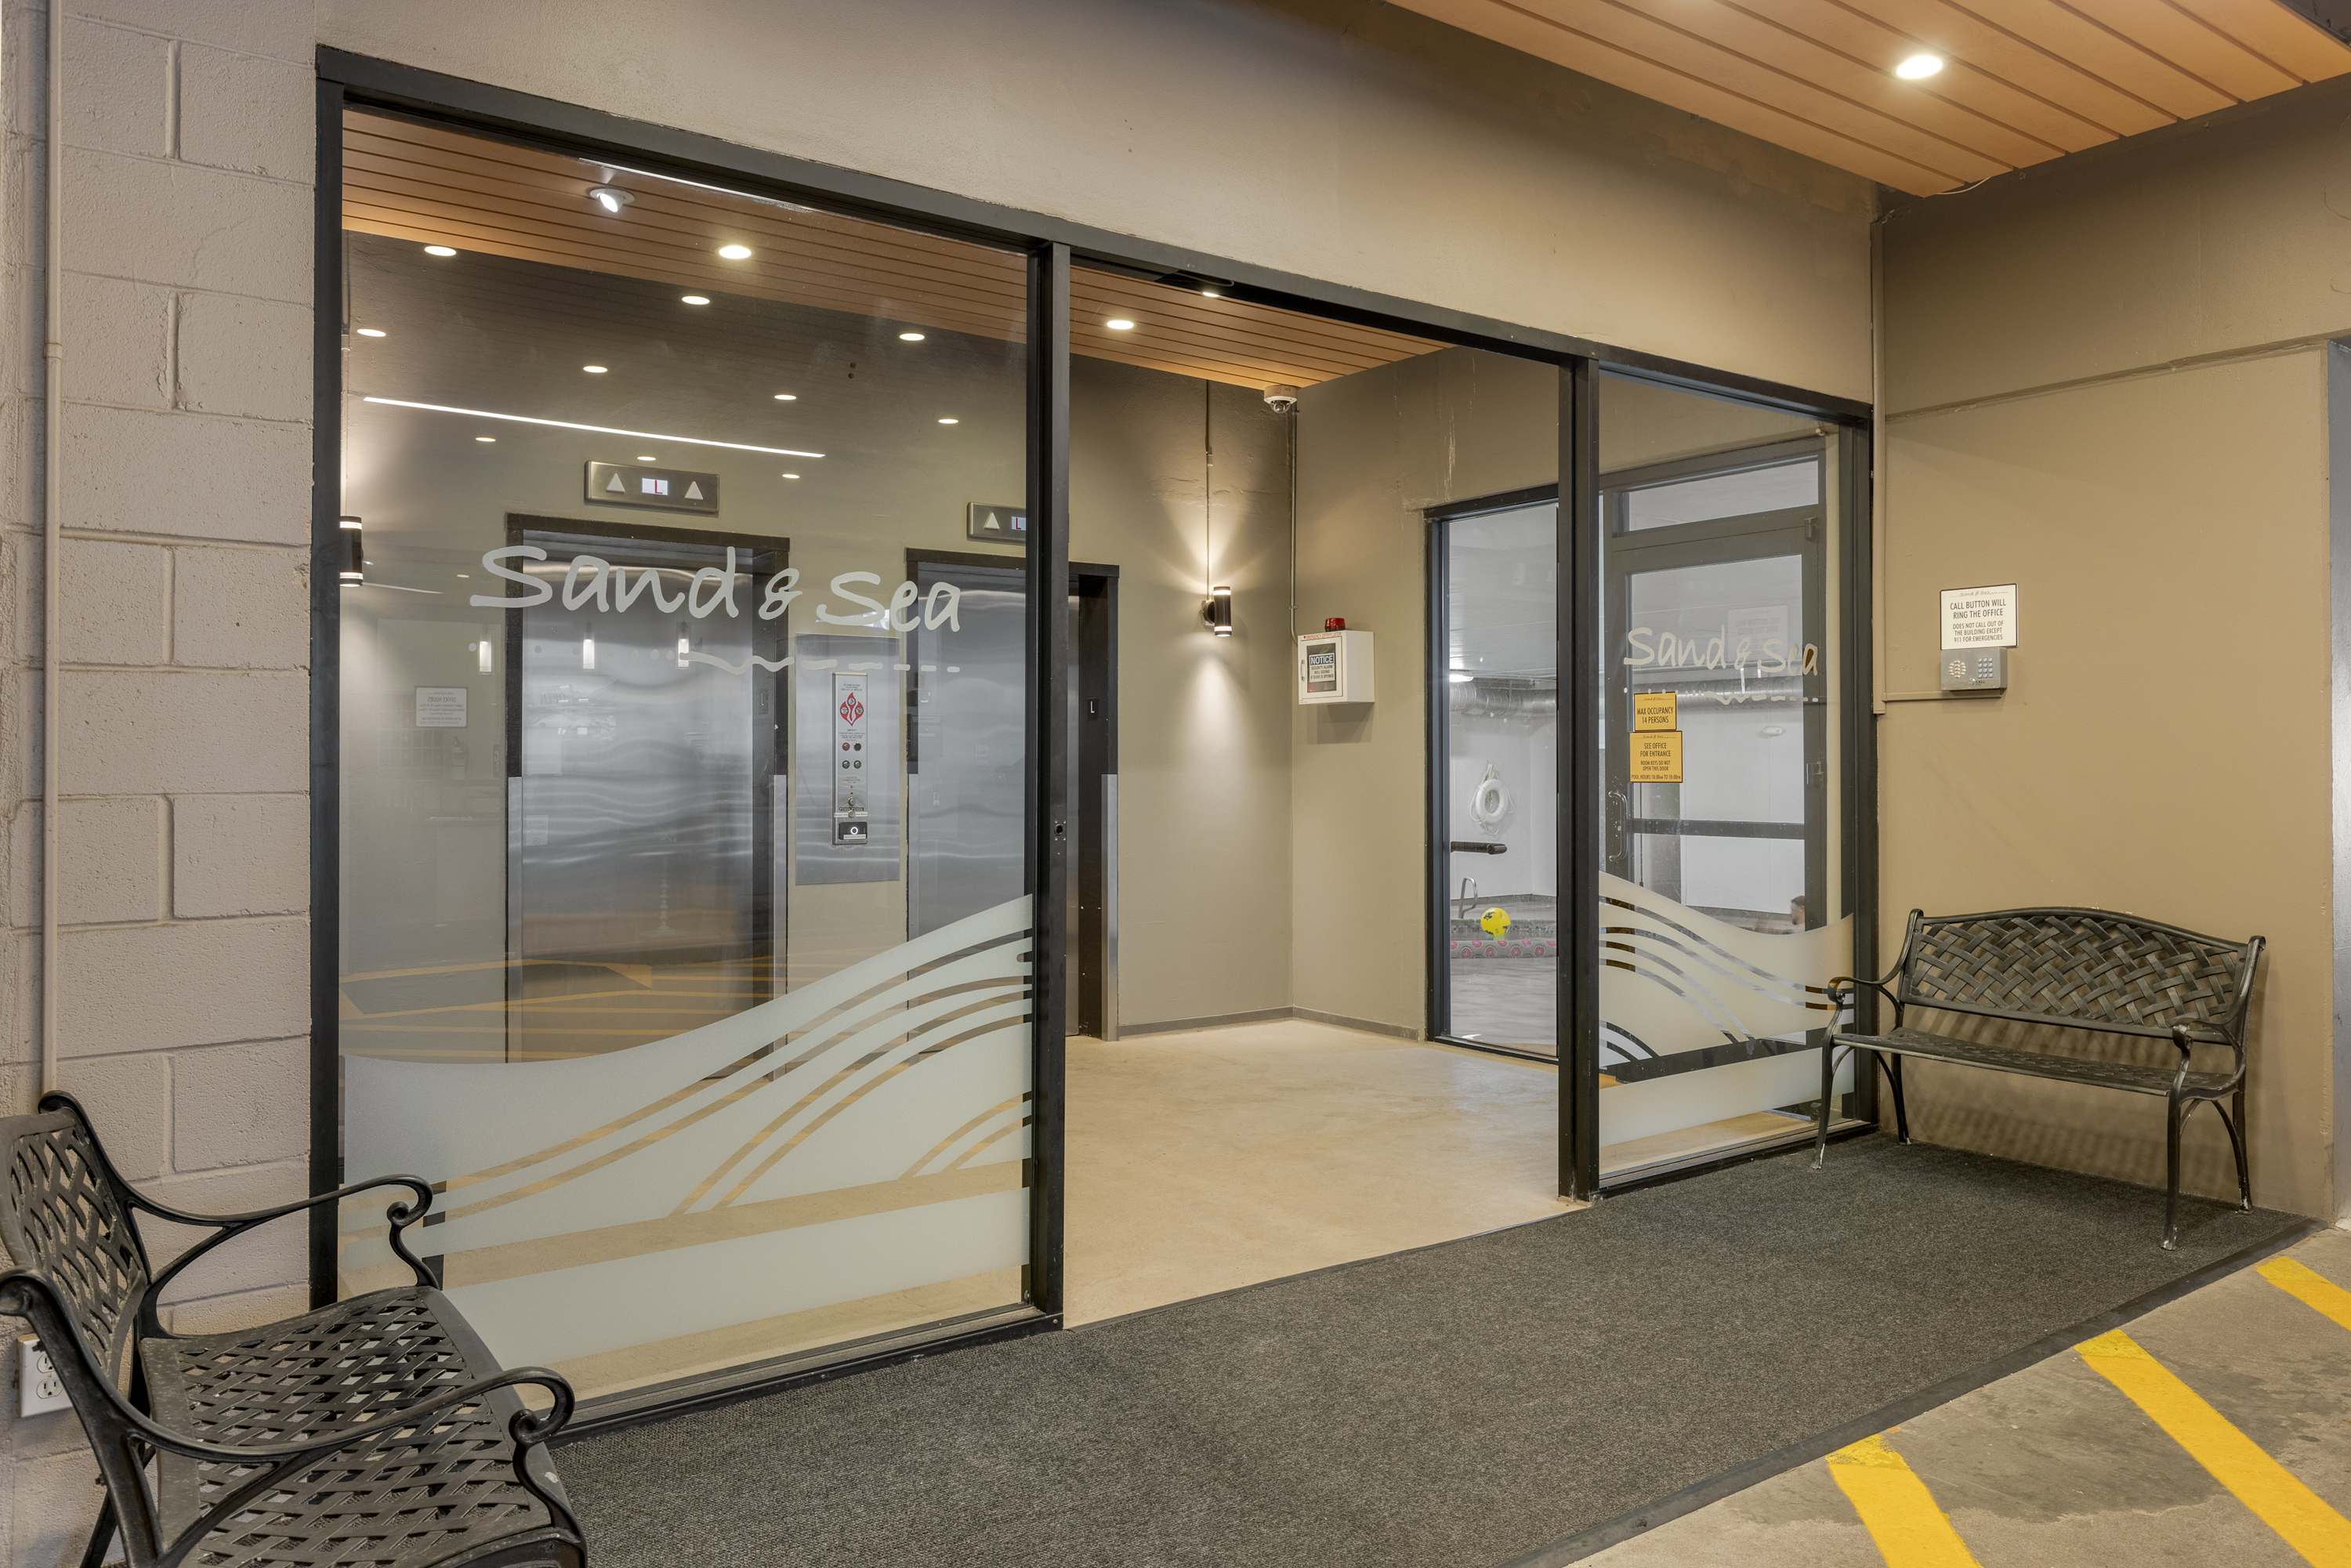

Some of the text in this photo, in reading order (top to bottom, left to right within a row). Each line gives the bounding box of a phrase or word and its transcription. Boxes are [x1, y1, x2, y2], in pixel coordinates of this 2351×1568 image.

[654, 480, 662, 494] L
[1016, 517, 1022, 530] L
[470, 546, 961, 632] Sand & Sea
[1624, 626, 1726, 670] Sand
[1733, 638, 1751, 670] &
[1757, 639, 1818, 677] Sea
[1310, 655, 1333, 664] NOTICE
